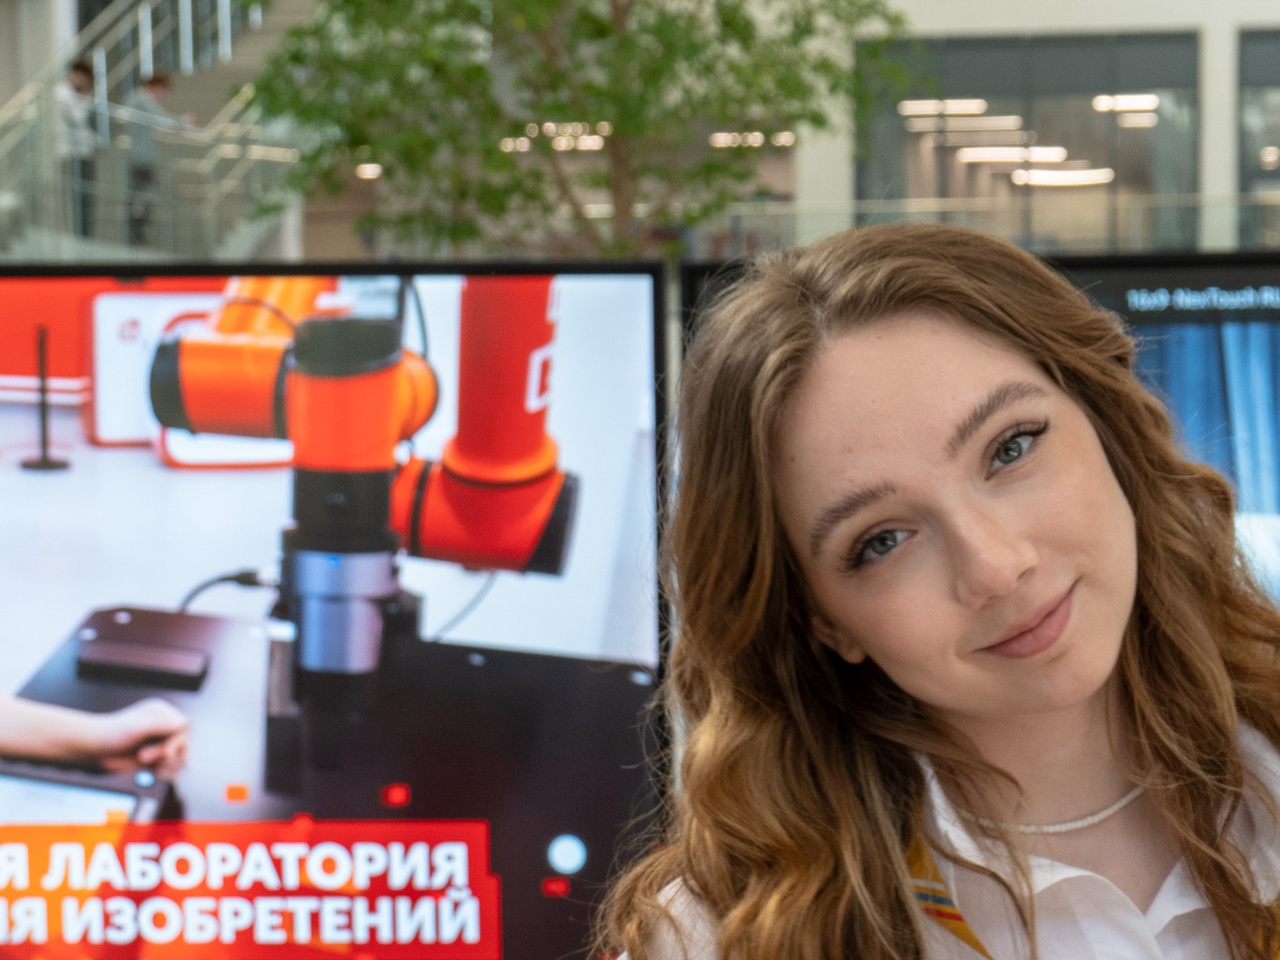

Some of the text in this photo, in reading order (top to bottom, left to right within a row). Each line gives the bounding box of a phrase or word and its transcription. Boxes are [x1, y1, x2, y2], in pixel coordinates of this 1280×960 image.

[41, 842, 469, 890] ЛАБОРАТОРИЯ
[0, 887, 480, 944] Я ИЗОБРЕТЕНИЙ
